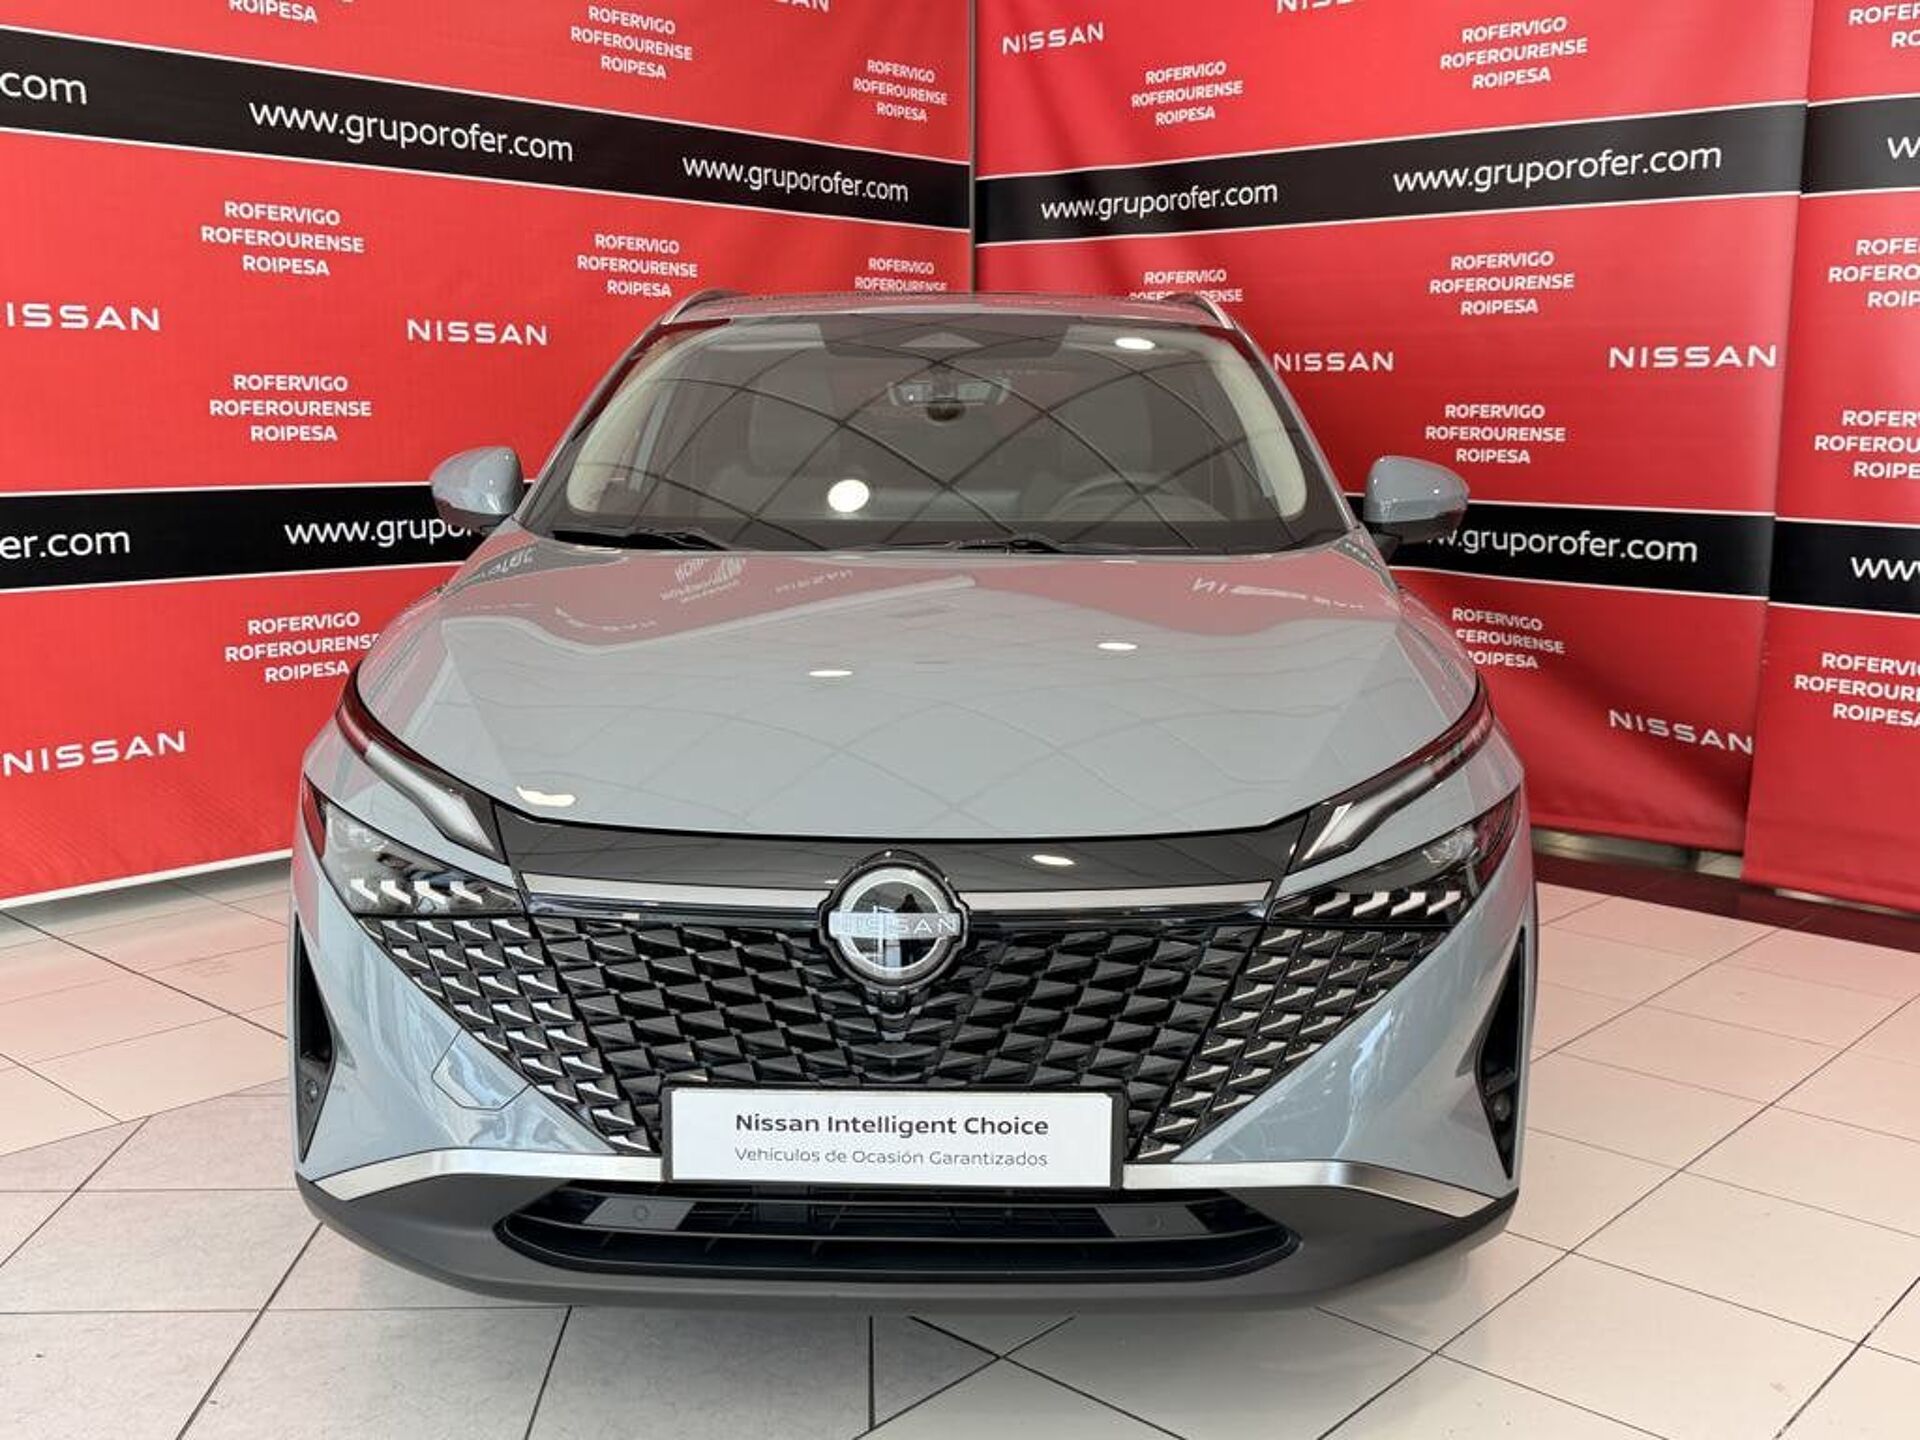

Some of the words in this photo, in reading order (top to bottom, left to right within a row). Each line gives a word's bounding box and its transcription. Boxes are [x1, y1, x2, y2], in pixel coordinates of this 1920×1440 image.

[589, 6, 675, 34] ROFERVIGO
[1463, 17, 1567, 42] ROFERVIGO
[571, 26, 692, 60] ROFEROURENSE
[1003, 23, 1103, 54] NISSAN
[1441, 38, 1587, 69] ROFEROURENSE
[601, 55, 666, 78] ROIPESA
[868, 60, 934, 83] ROFERVIGO
[1146, 61, 1226, 84] ROFERVIGO
[1472, 67, 1550, 88] ROIPESA
[854, 78, 947, 105] ROFEROURENSE
[1132, 81, 1242, 106] ROFEROURENSE
[877, 102, 927, 121] ROIPESA
[1156, 106, 1215, 125] ROIPESA
[249, 103, 572, 161] www.gruporofer.com
[683, 158, 908, 201] www.gruporofer.com
[1394, 148, 1721, 192] www.gruporofer.com
[1041, 184, 1277, 220] www.gruporofer.com
[225, 202, 340, 225] ROFERVIGO
[202, 226, 363, 252] ROFEROURENSE
[595, 234, 679, 254] ROFERVIGO
[243, 255, 329, 275] ROIPESA
[578, 255, 697, 277] ROFEROURENSE
[869, 258, 934, 274] ROFERVIGO
[1451, 251, 1554, 270] ROFERVIGO
[1144, 270, 1226, 284] ROFERVIGO
[1430, 274, 1574, 293] ROFEROURENSE
[607, 280, 671, 297] ROIPESA
[1461, 299, 1537, 315] ROIPESA
[408, 320, 546, 345] NISSAN
[1273, 352, 1394, 371] NISSAN
[1610, 345, 1776, 367] NISSAN
[234, 375, 347, 391] ROFERVIGO
[210, 400, 371, 416] ROFEROURENSE
[1446, 405, 1545, 418] ROFERVIGO
[251, 426, 337, 441] ROIPESA
[1426, 426, 1565, 441] ROFEROURENSE
[1457, 448, 1530, 463] ROIPESA
[248, 612, 360, 635] ROFERVIGO
[1452, 608, 1542, 631] ROFERVIGO
[265, 661, 349, 682] ROIPESA
[1610, 710, 1752, 754] NISSAN
[3, 731, 184, 776] NISSAN
[737, 1114, 819, 1131] Nissan
[829, 1116, 956, 1138] Intelligent
[965, 1117, 1048, 1134] Choice
[735, 1146, 820, 1161] Vehículos
[824, 1149, 847, 1162] de
[852, 1149, 923, 1163] Ocasión
[930, 1151, 1047, 1166] Garantizados
